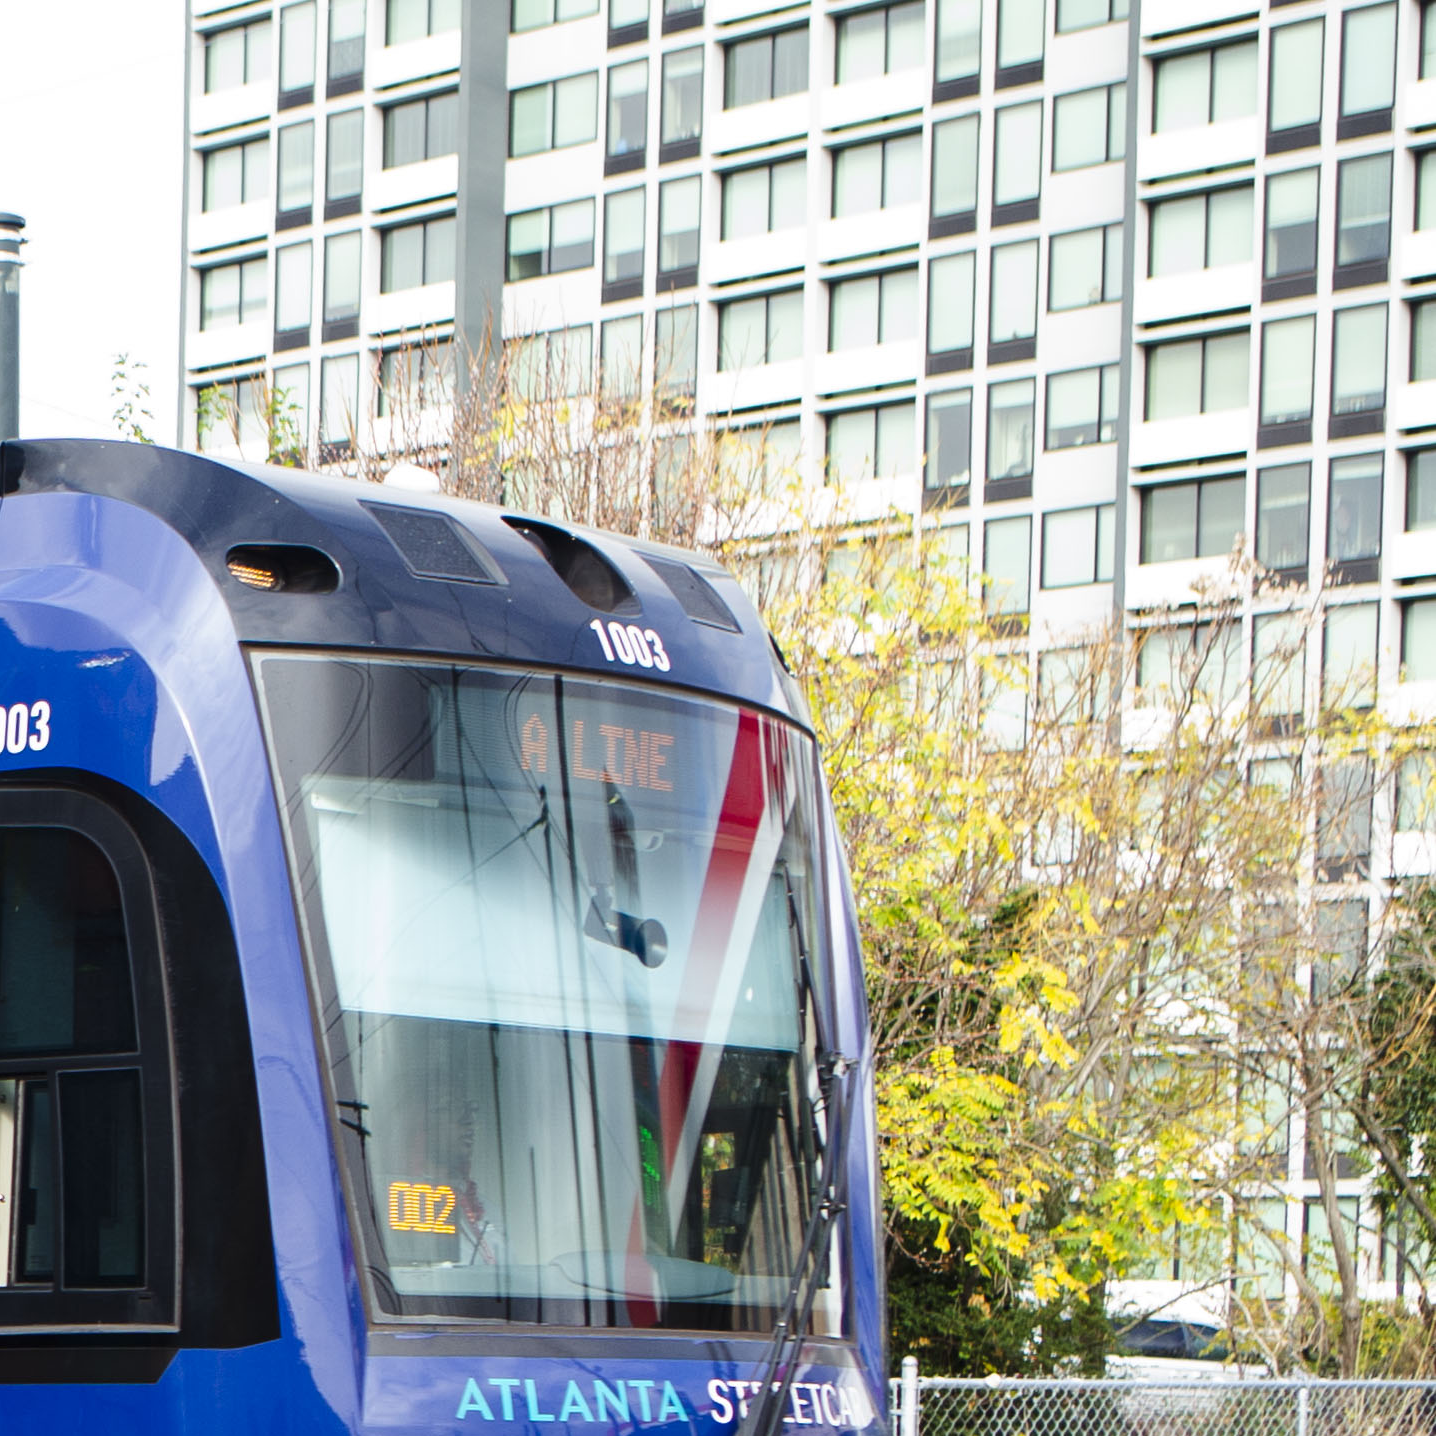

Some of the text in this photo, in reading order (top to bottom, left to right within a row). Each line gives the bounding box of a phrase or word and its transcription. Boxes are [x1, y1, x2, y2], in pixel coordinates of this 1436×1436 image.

[590, 618, 671, 672] 1003
[520, 713, 675, 793] A LINE
[388, 1182, 456, 1234] 002
[456, 1377, 871, 1428] ATLANTA STETCA
